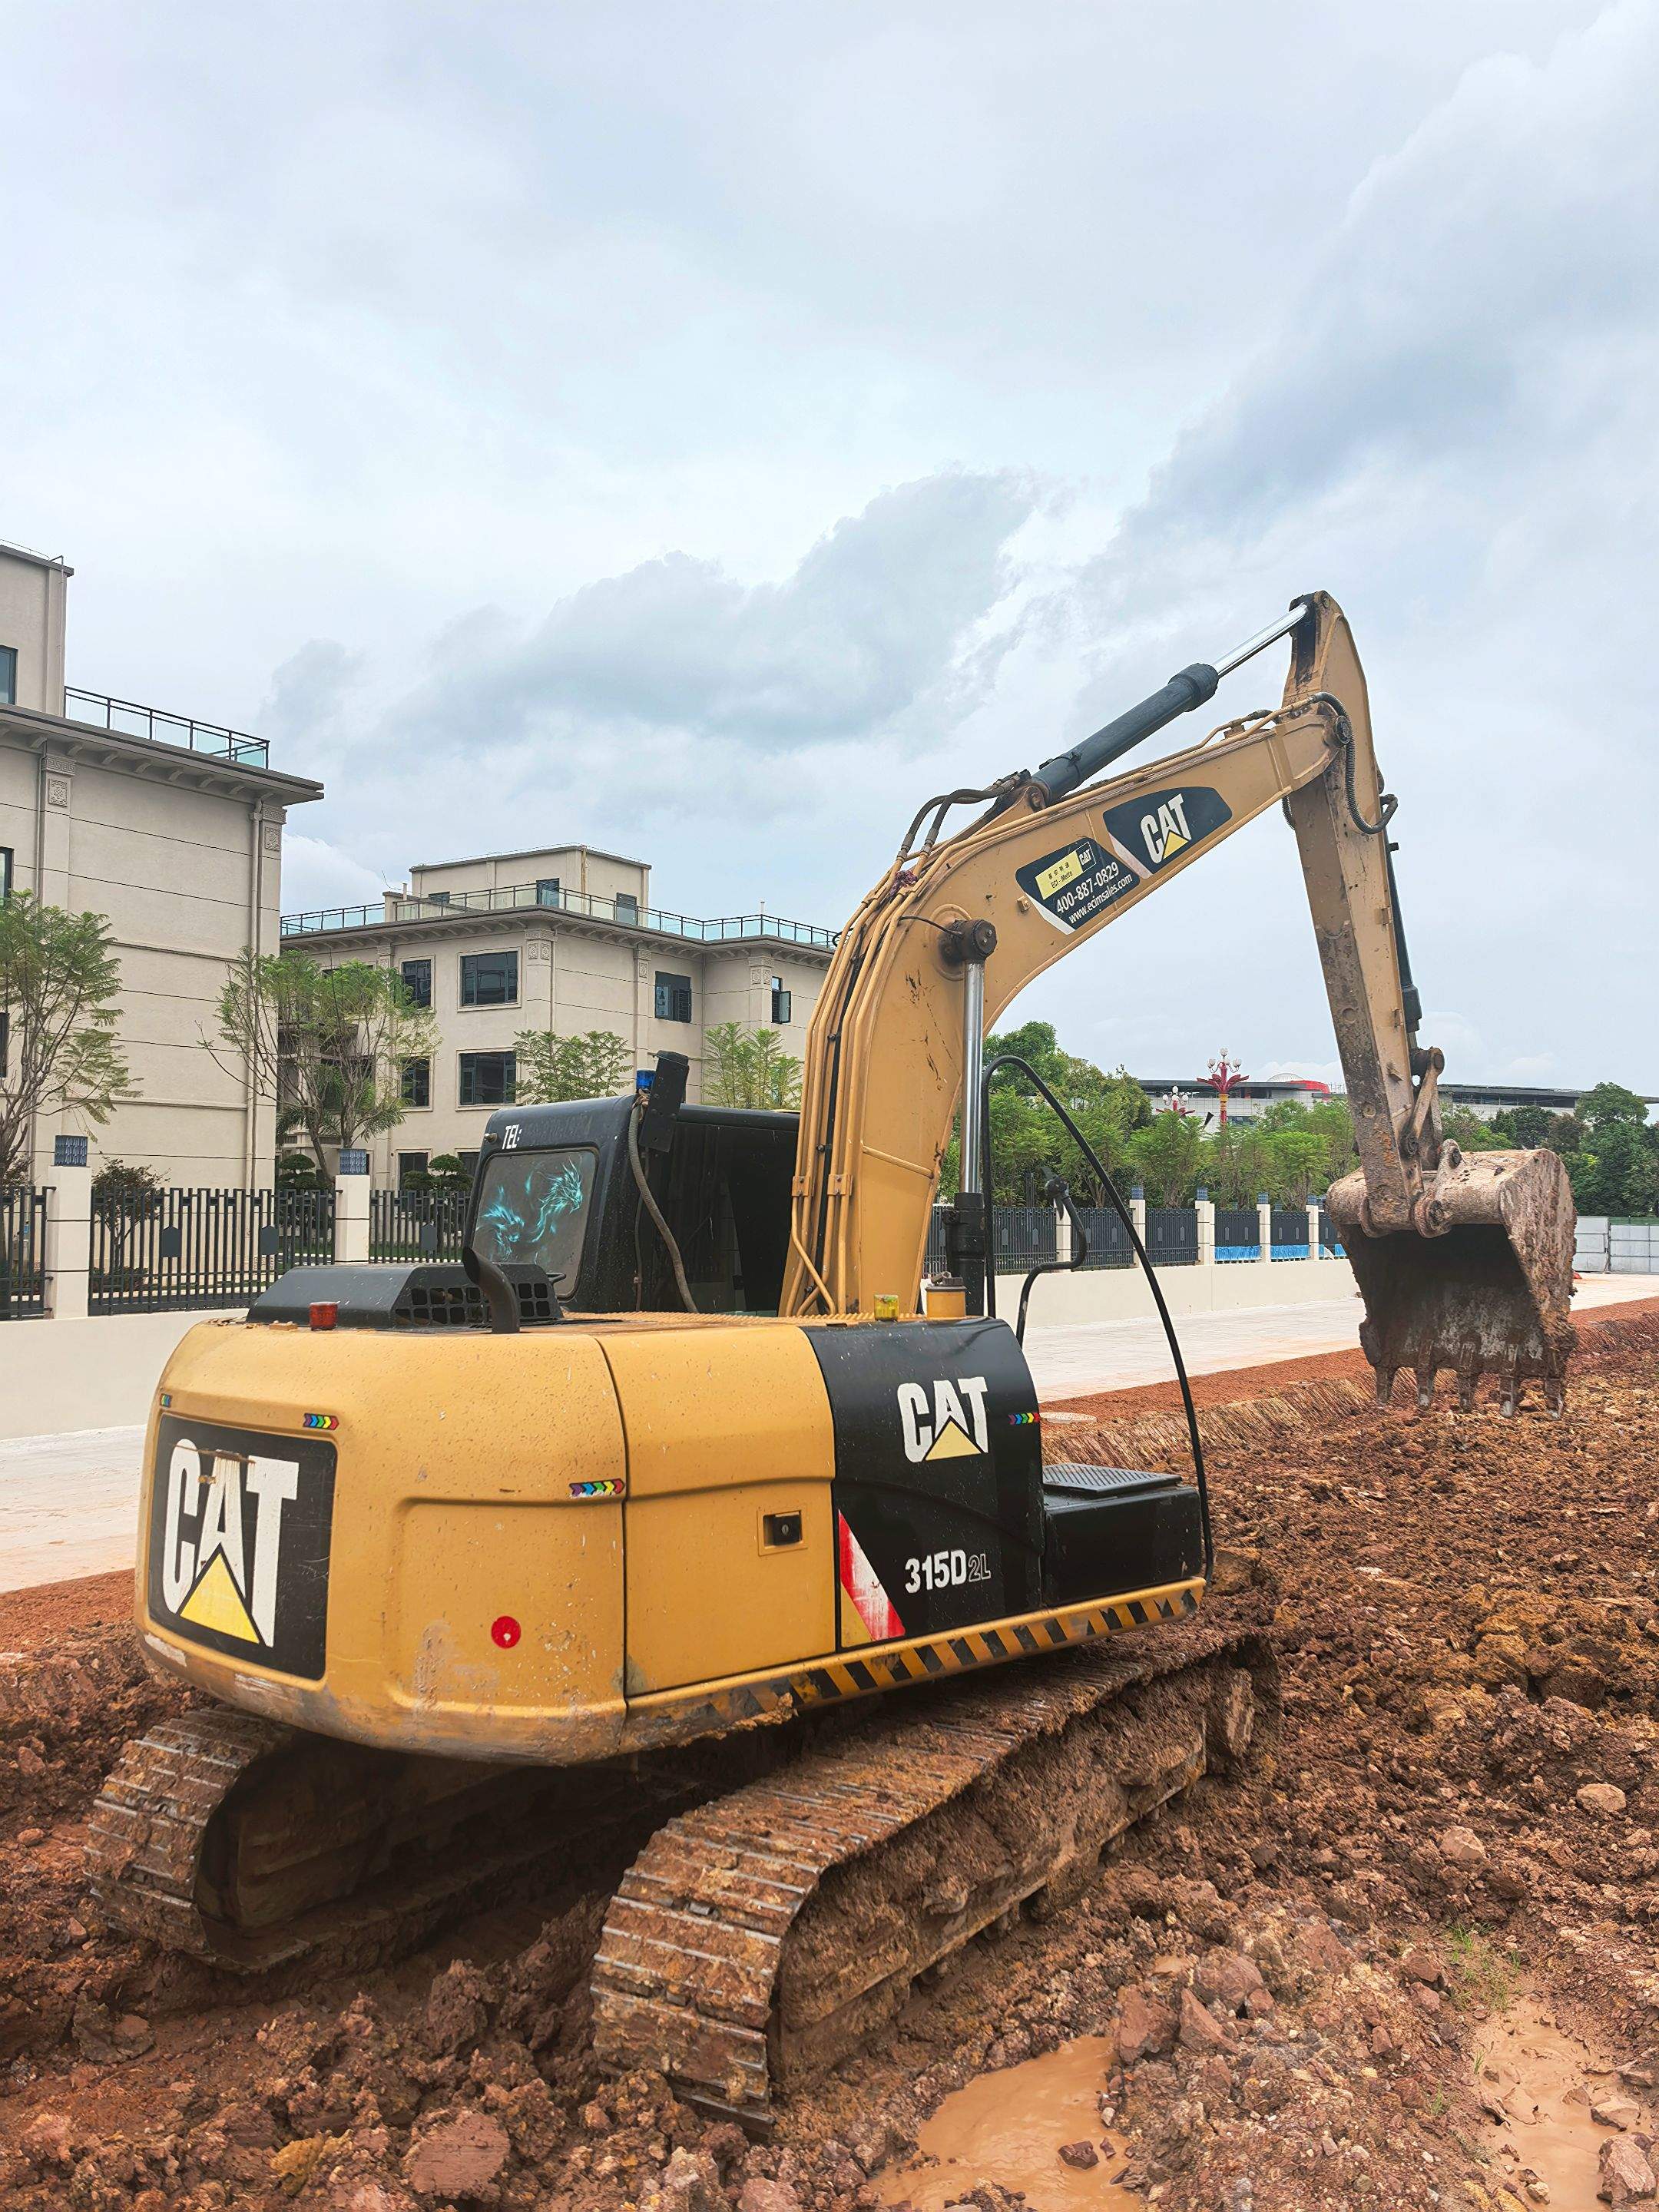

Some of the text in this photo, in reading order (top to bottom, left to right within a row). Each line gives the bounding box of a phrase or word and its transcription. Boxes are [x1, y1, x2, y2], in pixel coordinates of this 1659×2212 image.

[1141, 793, 1191, 863] CAT
[1079, 849, 1091, 865] CAT
[1057, 862, 1119, 913] 400-887-0829
[1069, 874, 1133, 924] www.ecimsales.com
[502, 1124, 522, 1150] TEL:
[897, 1376, 988, 1462] CAT
[162, 1439, 300, 1647] CAT
